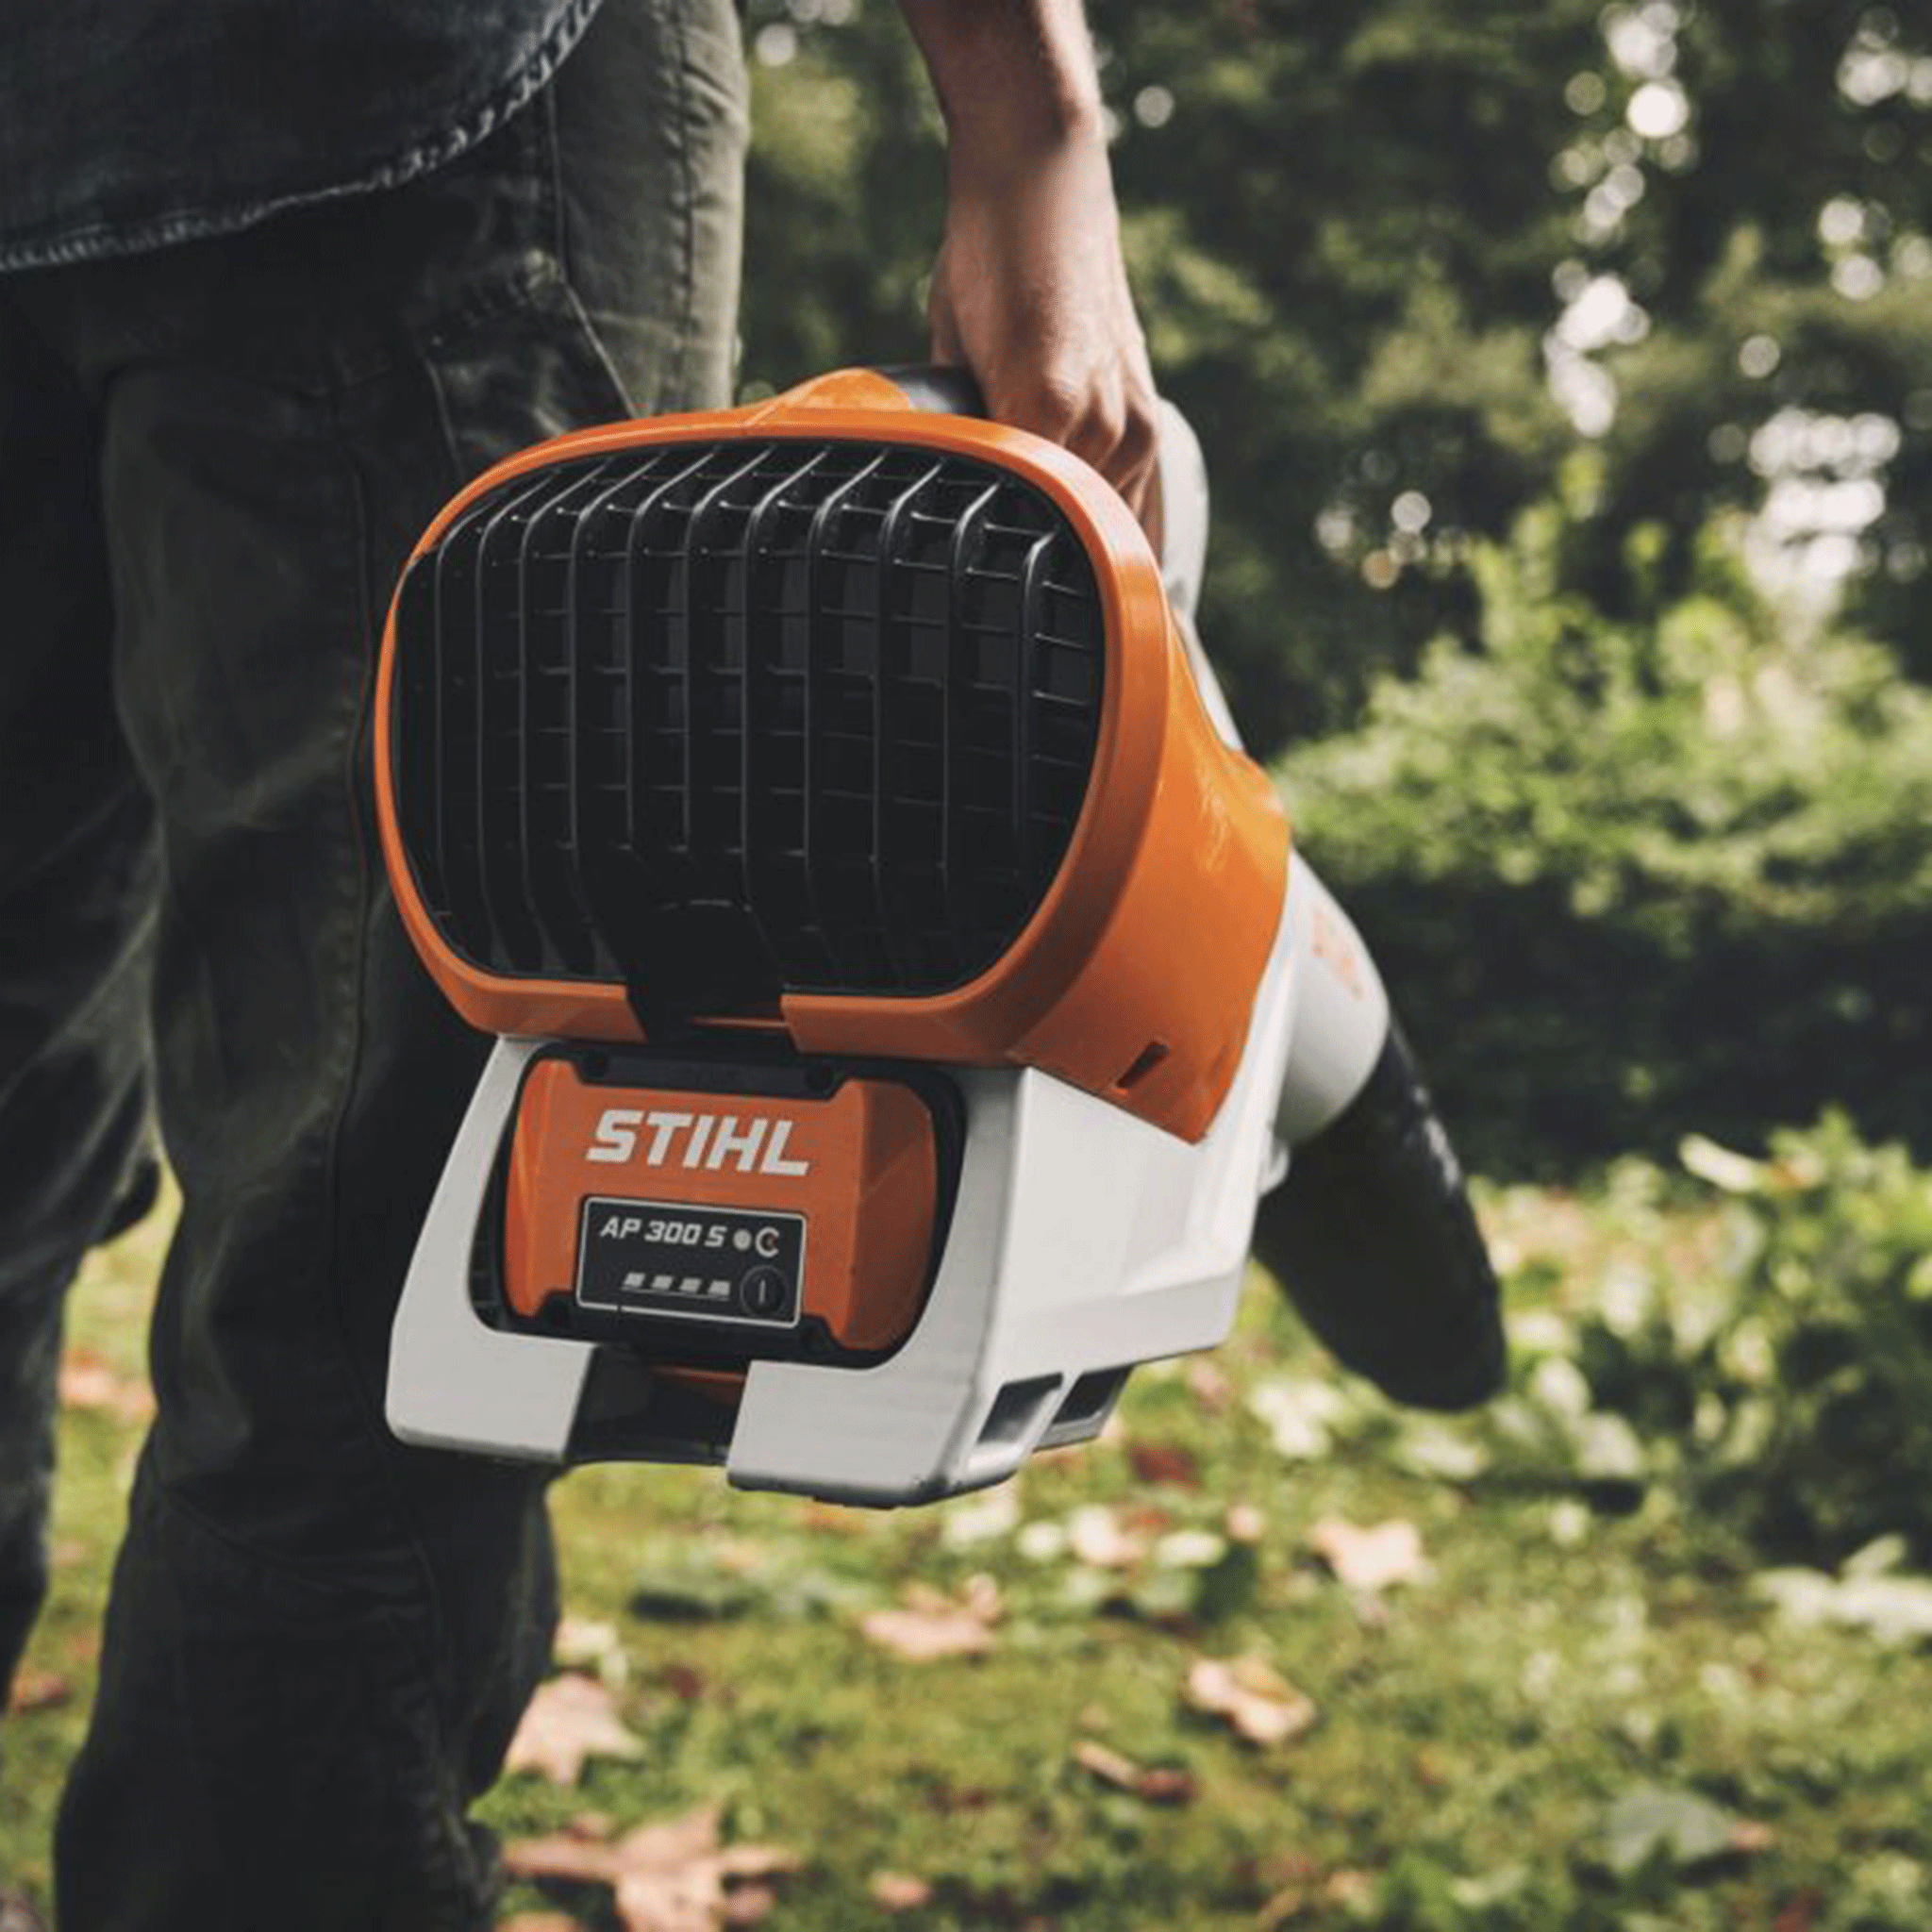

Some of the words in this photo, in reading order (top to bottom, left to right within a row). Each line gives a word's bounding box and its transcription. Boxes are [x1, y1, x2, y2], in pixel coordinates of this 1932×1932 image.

[586, 1109, 809, 1176] STIHL
[600, 1216, 641, 1239] AP
[644, 1221, 702, 1244] 300
[704, 1225, 727, 1247] S
